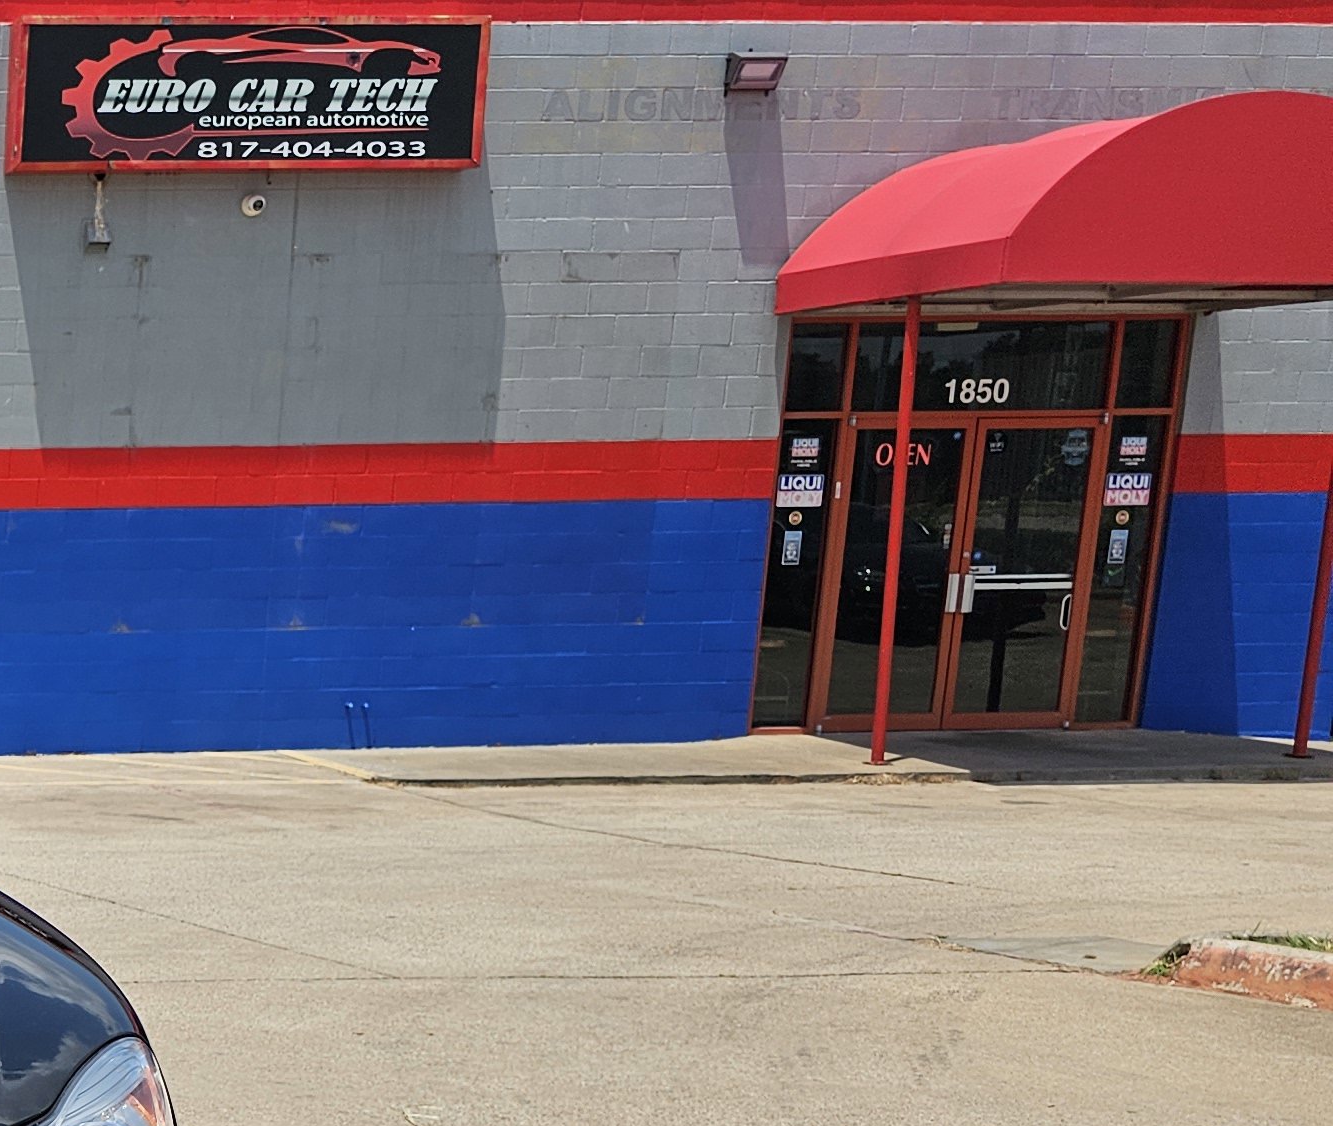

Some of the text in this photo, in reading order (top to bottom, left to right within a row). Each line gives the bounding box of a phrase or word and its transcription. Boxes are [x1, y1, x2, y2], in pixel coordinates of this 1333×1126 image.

[97, 78, 439, 113] EURO CAR TECH
[198, 112, 429, 130] european automotive
[197, 141, 426, 158] 817-404-4033
[945, 378, 1010, 404] 1850
[875, 443, 932, 467] OEN
[780, 476, 822, 491] LIQUI
[1108, 475, 1150, 489] LIQUI
[1106, 490, 1149, 504] MOLY
